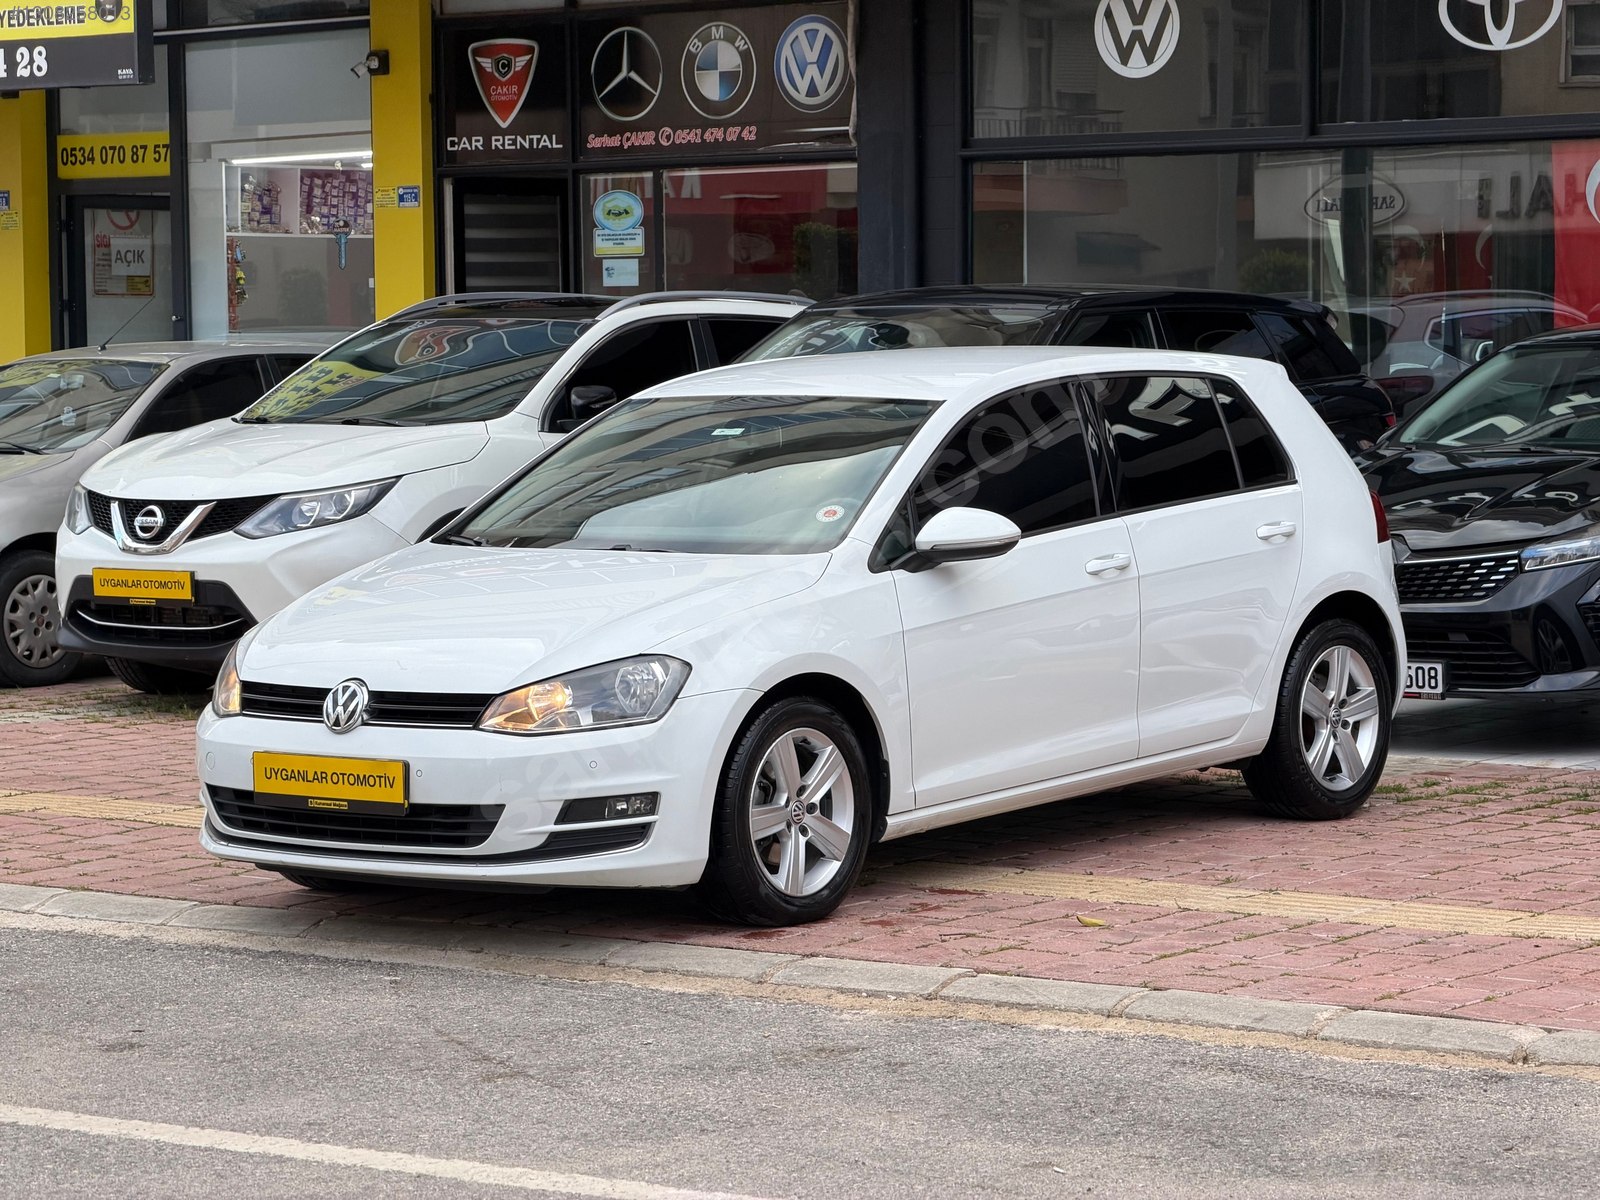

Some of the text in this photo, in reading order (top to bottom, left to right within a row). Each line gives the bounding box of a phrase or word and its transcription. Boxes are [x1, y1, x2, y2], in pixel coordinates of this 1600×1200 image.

[689, 25, 748, 54] BMW
[16, 46, 48, 77] 28
[447, 134, 563, 151] CAR RENTAL
[587, 125, 757, 149] Serhat ÇAKIR 0541 474 07 42
[61, 143, 170, 166] 0534 070 87 57
[114, 249, 145, 268] AÇIK
[99, 578, 186, 591] UYGANLAR OTOMOTİV
[264, 766, 396, 789] UYGANLAR OTOMOTİV
